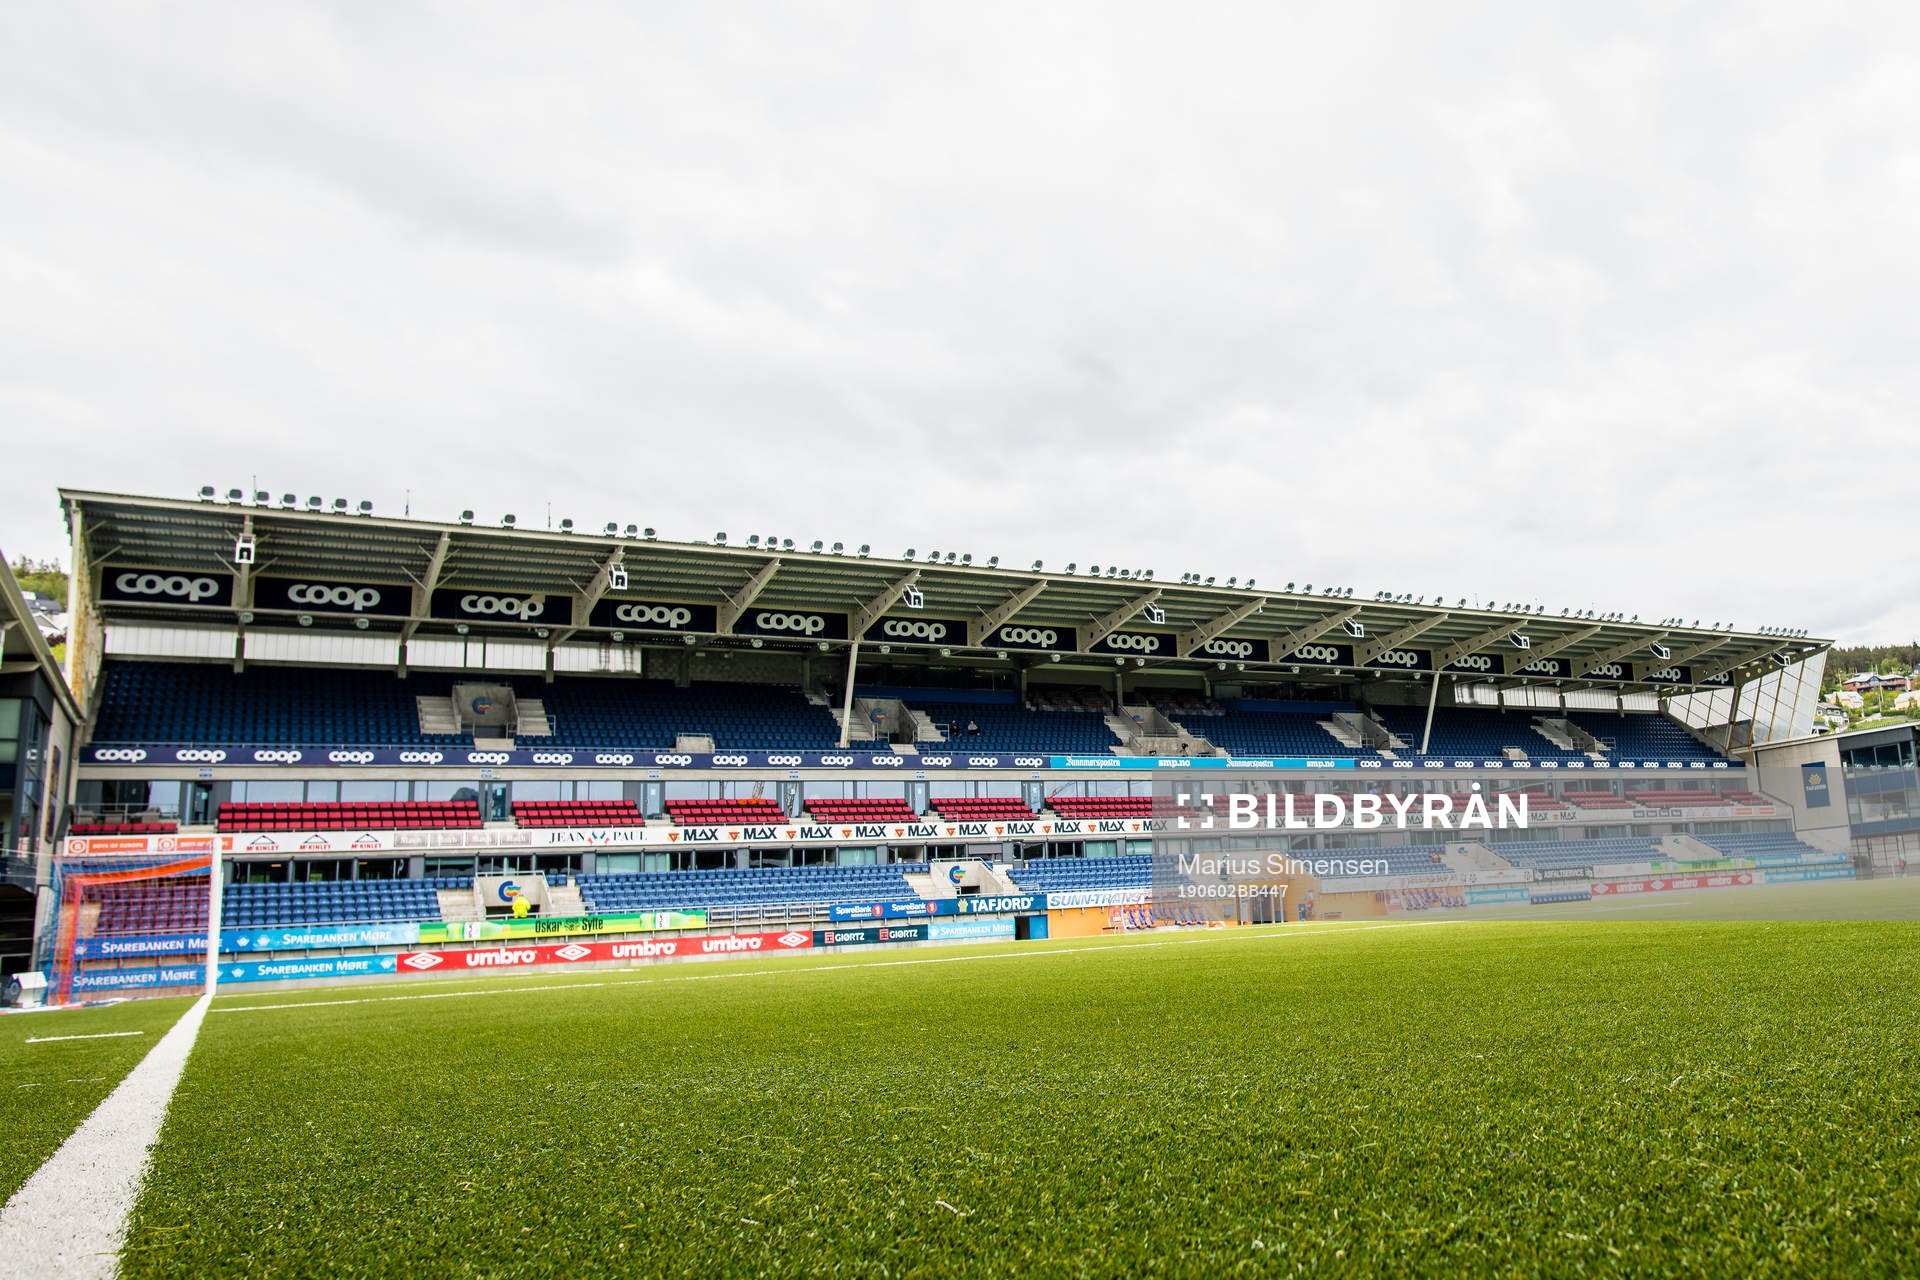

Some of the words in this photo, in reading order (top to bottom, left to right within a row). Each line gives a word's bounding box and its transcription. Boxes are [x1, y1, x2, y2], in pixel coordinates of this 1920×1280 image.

[116, 572, 219, 601] coop
[287, 584, 381, 611] coop
[460, 594, 544, 620] coop
[616, 604, 691, 628] coop
[756, 612, 824, 635] coop
[884, 619, 946, 642] coop
[1000, 626, 1057, 648] coop
[1106, 633, 1159, 653] coop
[1204, 640, 1252, 658] coop
[1294, 645, 1339, 663] coop
[95, 749, 147, 763] coop
[176, 750, 226, 763] coop
[254, 751, 302, 764] coop
[329, 751, 374, 764] coop
[400, 752, 443, 765] coop
[467, 753, 509, 765] coop
[533, 753, 573, 765] coop
[595, 754, 634, 766] coop
[655, 755, 692, 766] coop
[712, 755, 748, 766] coop
[768, 755, 801, 766] coop
[821, 756, 853, 766] coop
[872, 756, 903, 766] coop
[921, 757, 951, 767] coop
[969, 757, 998, 767] coop
[1015, 757, 1042, 767] coop
[1158, 759, 1190, 769] smp.no
[1306, 759, 1335, 769] smp.no
[1360, 760, 1381, 769] coop
[1393, 760, 1413, 769] coop
[1424, 760, 1444, 769] coop
[1454, 760, 1474, 769] coop
[1484, 760, 1503, 769] coop
[1513, 760, 1531, 769] coop
[1531, 812, 1548, 821] MAX
[1560, 811, 1577, 820] MAX
[549, 832, 585, 844] JEAN
[613, 831, 647, 842] PAUL
[683, 828, 718, 841] MAX
[743, 827, 776, 840] MAX
[800, 826, 832, 839] MAX
[855, 825, 886, 838] MAX
[908, 824, 938, 837] MAX
[959, 823, 988, 836] MAX
[1007, 822, 1035, 834] MAX
[1054, 821, 1081, 833] MAX
[1099, 820, 1125, 832] MAX
[1143, 820, 1168, 831] MAX
[1616, 882, 1643, 892] umbro
[1671, 877, 1698, 888] umbro
[1707, 875, 1732, 886] umbro
[835, 905, 872, 915] SpareBank
[891, 902, 926, 912] SpareBank
[971, 897, 1032, 911] TAFJORD
[535, 921, 562, 933] Oskar
[889, 929, 918, 939] GIØRTZ
[283, 932, 357, 945] SPAREBANKEN
[702, 936, 761, 952] umbro
[835, 932, 864, 943] GIØRTZ
[612, 941, 676, 958] umbro
[466, 949, 536, 966] umbro
[258, 963, 333, 976] SPAREBANKEN
